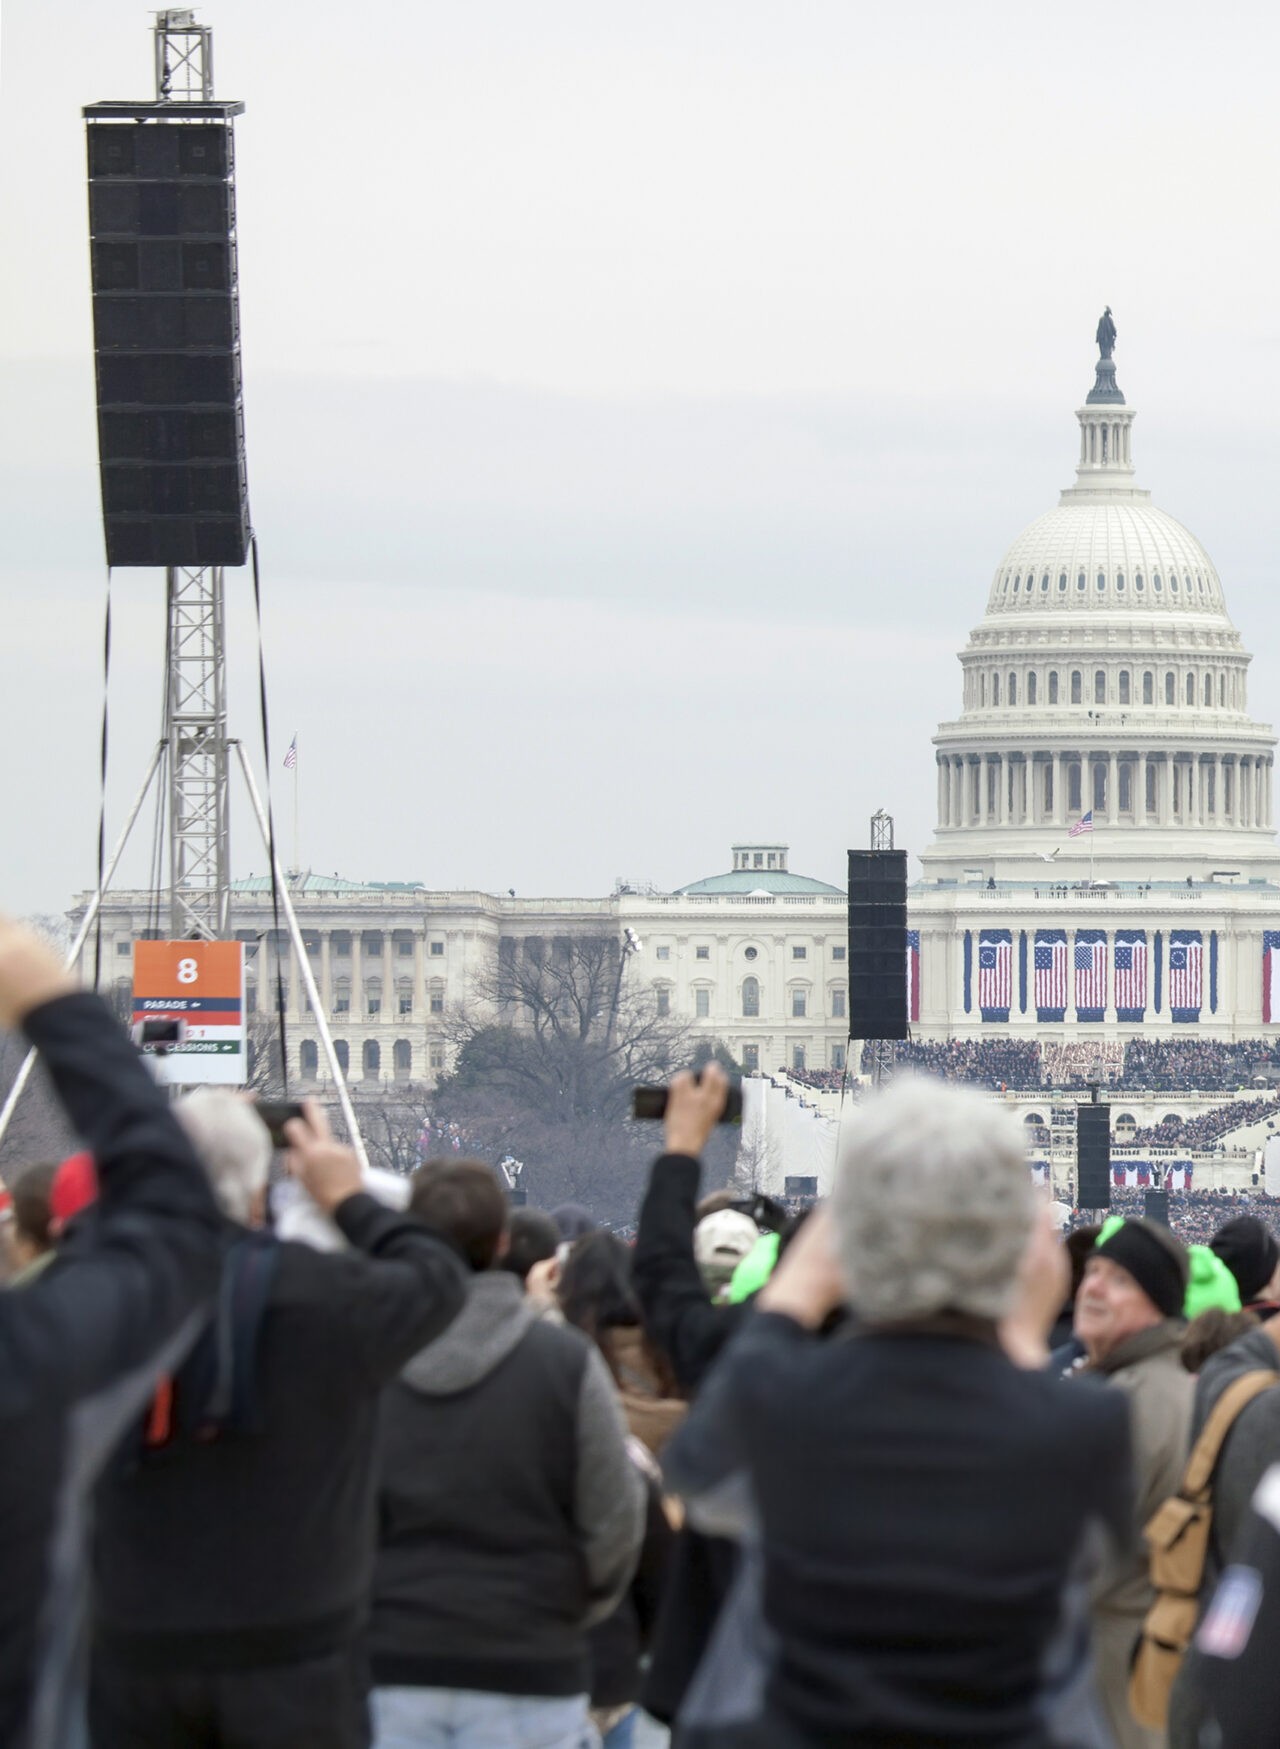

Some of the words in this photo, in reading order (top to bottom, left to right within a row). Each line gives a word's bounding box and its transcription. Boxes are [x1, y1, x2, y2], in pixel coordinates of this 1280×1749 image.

[177, 958, 198, 983] 8
[143, 1000, 188, 1010] PARADE
[143, 1043, 219, 1052] COCESSIONS
